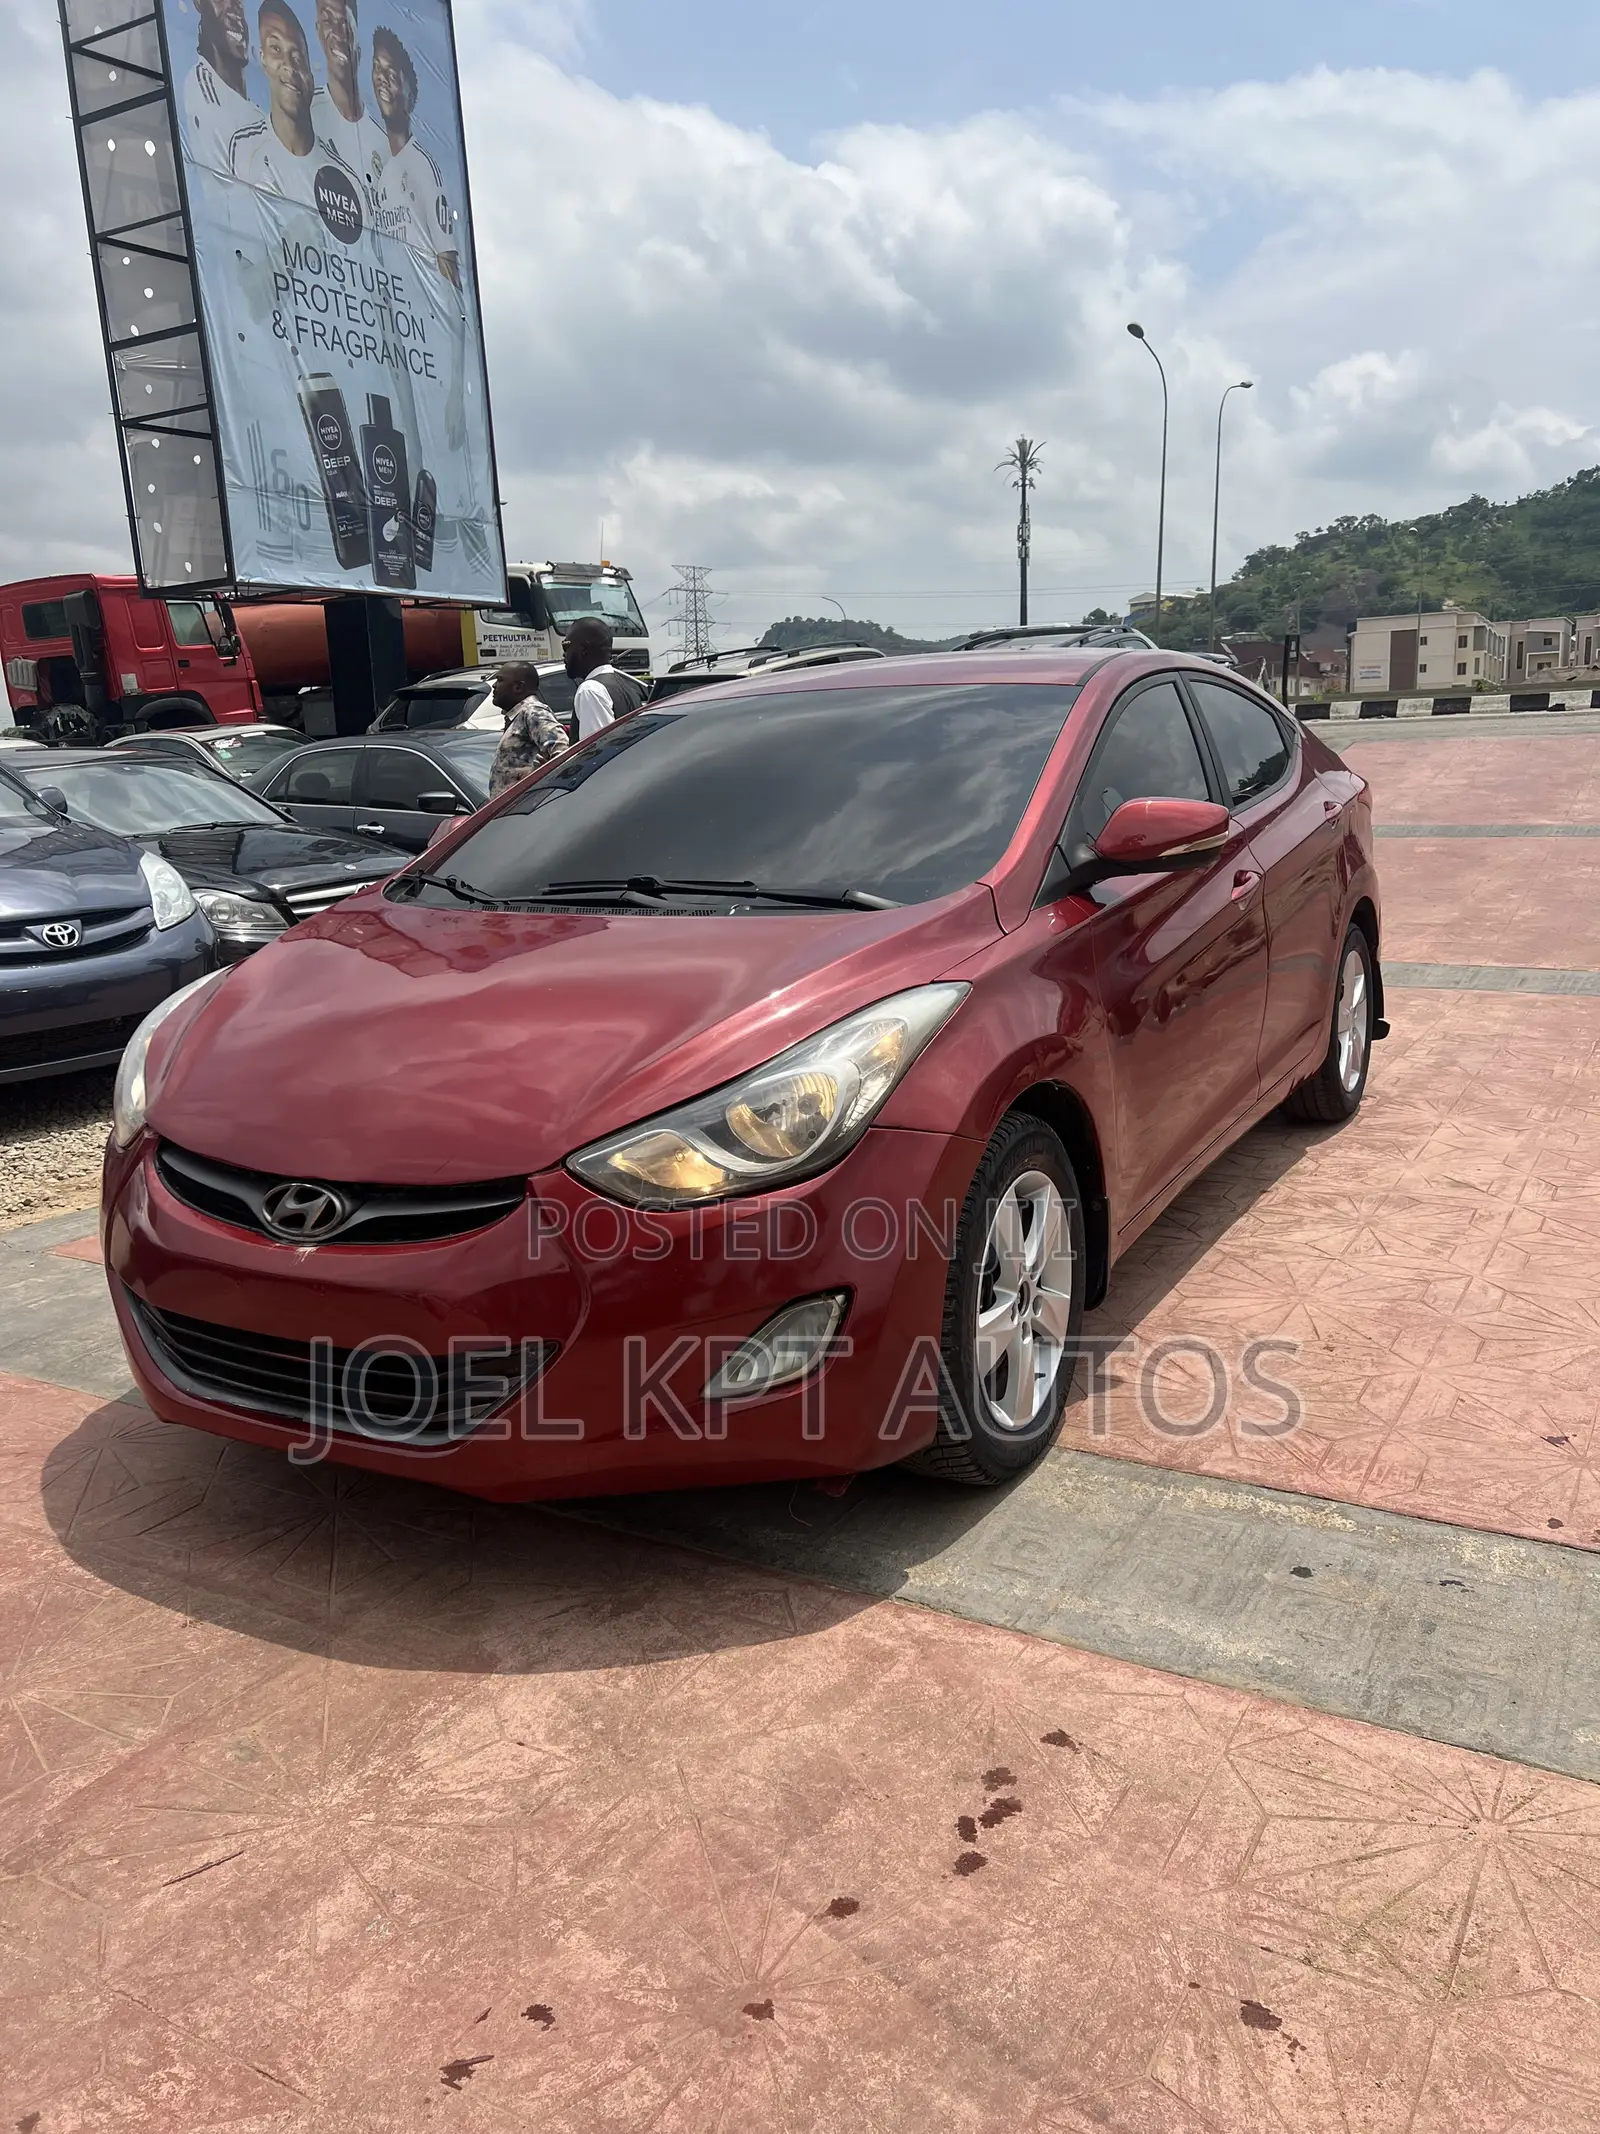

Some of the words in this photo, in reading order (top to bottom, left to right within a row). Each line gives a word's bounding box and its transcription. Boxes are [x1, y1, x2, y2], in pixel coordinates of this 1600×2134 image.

[318, 186, 359, 215] NIVEA
[326, 206, 356, 229] MEN
[281, 237, 412, 310] MOISTURE,
[273, 271, 426, 344] PROTECTION
[272, 309, 289, 341] &
[294, 314, 437, 380] FRAGRANCE
[320, 425, 339, 435] NIVEA
[324, 433, 338, 441] MEN
[323, 455, 351, 470] DEEP
[375, 457, 394, 468] NIVEA
[378, 466, 393, 474] MEN
[374, 495, 398, 507] DEEP
[483, 634, 532, 642] PEETHULTRA
